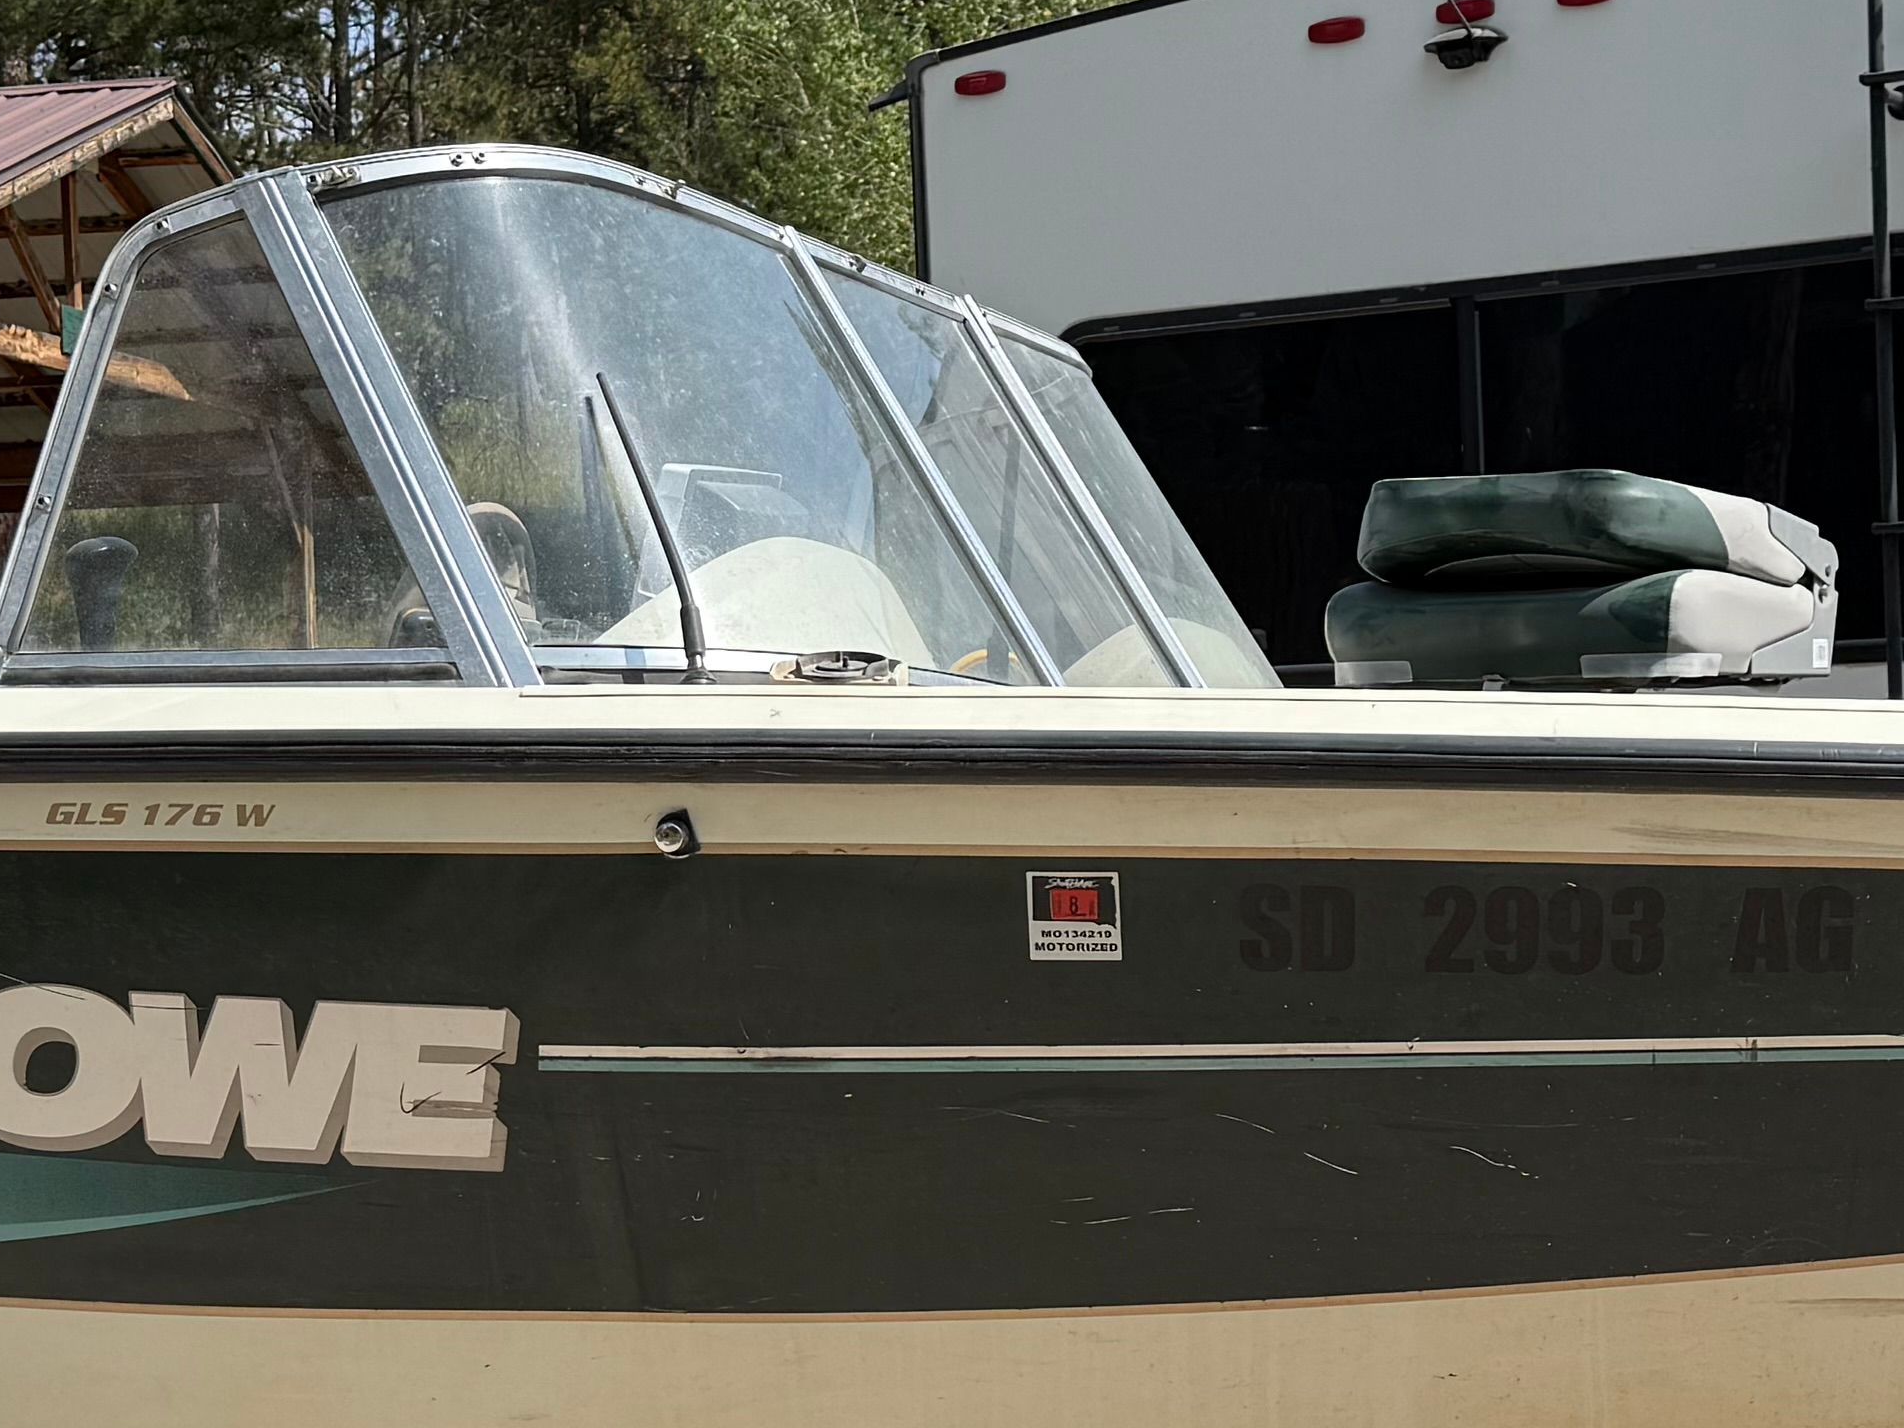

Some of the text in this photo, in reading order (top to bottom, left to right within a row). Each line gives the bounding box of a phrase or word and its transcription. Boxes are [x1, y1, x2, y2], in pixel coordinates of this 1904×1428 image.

[45, 802, 276, 827] GLS 176 W
[1238, 883, 1856, 975] SD 2993 AG
[1035, 942, 1118, 952] MOTORIZED
